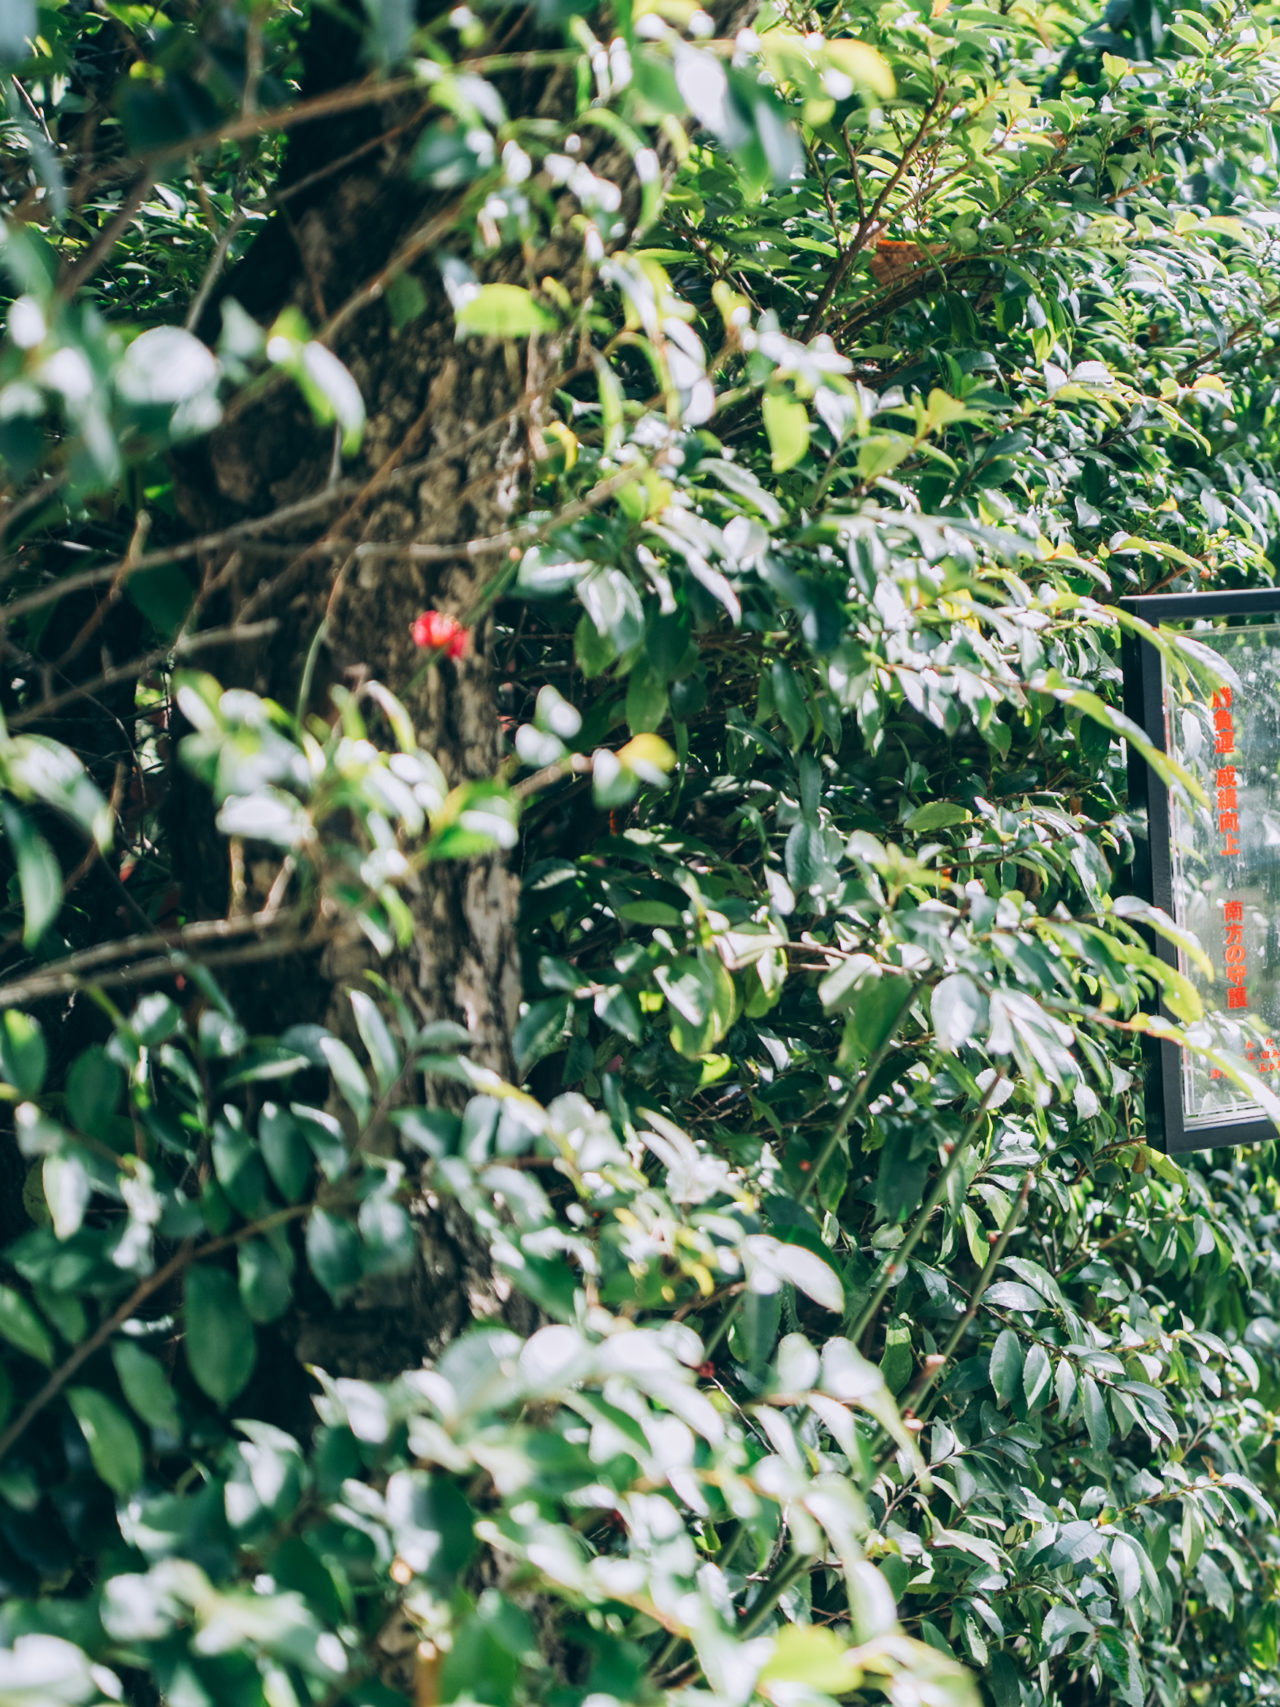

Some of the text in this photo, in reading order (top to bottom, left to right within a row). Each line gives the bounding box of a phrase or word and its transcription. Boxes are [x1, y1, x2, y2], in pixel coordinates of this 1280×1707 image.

[1216, 764, 1241, 856] 成績向上
[1223, 900, 1248, 1009] 南方の守護
